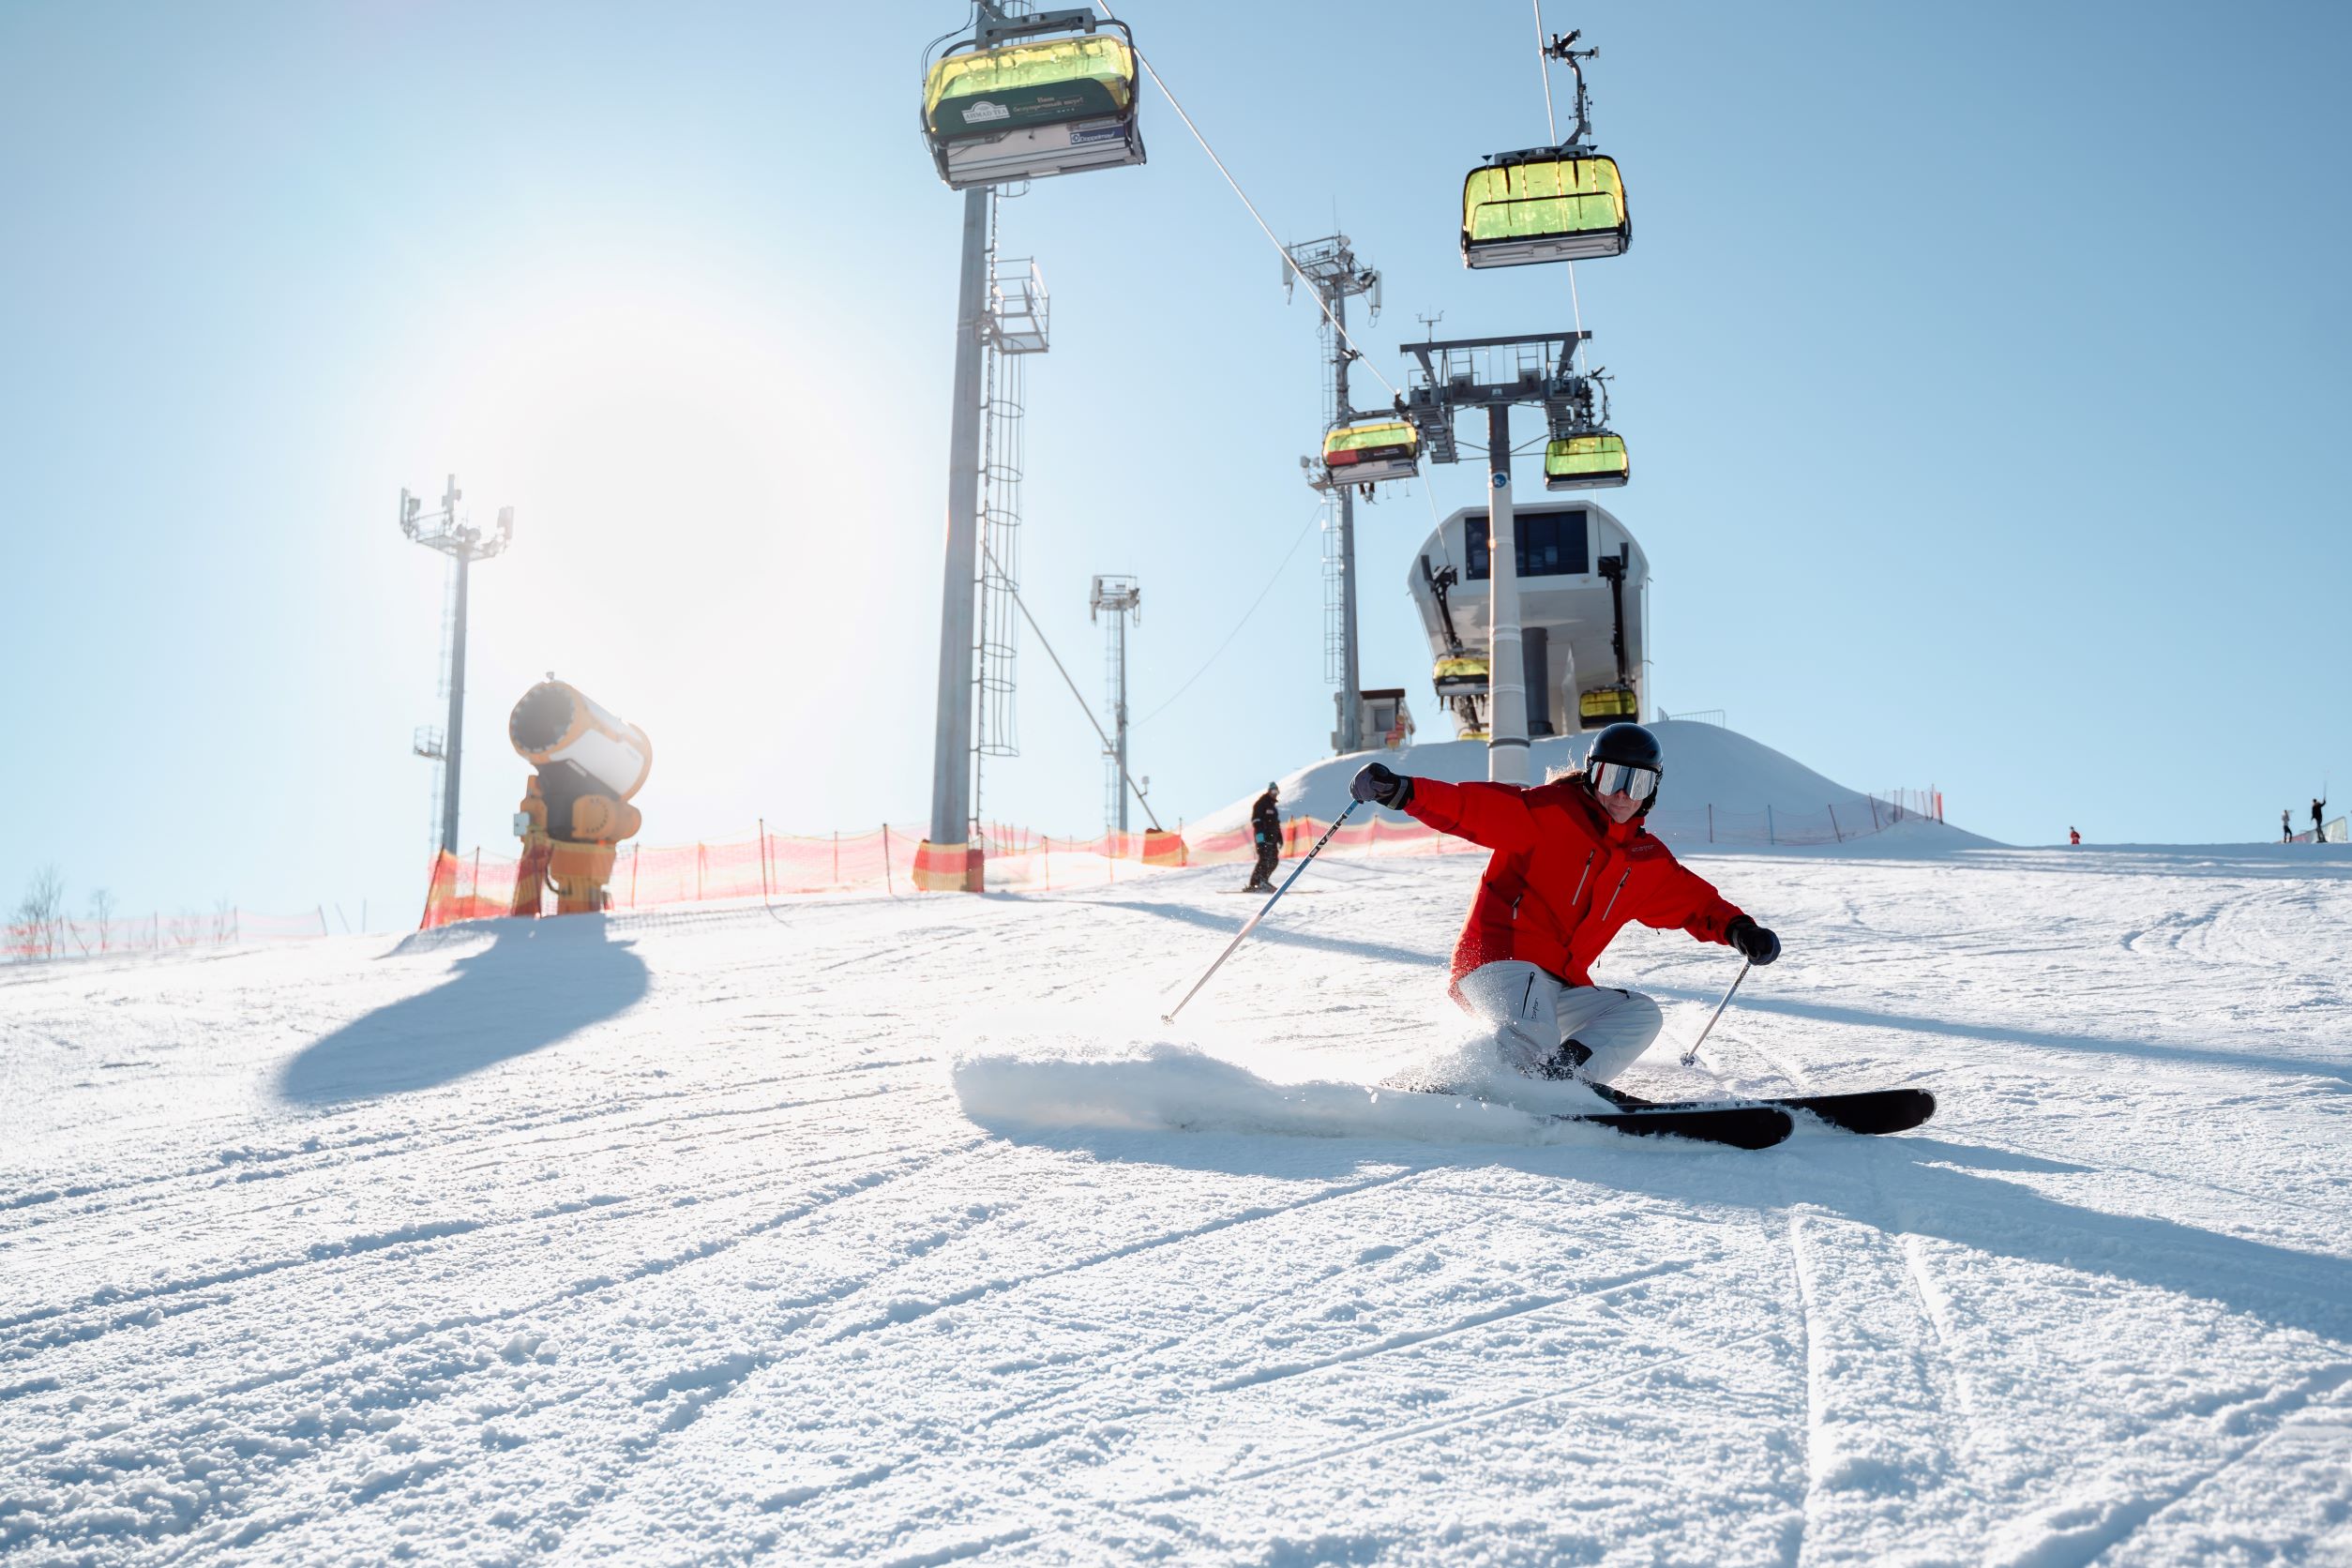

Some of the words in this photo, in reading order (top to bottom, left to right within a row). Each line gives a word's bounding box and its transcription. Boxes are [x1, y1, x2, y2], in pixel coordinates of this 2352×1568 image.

[966, 109, 992, 120] AHMAD
[993, 107, 1007, 115] TEA
[1308, 813, 1348, 857] HEAD
